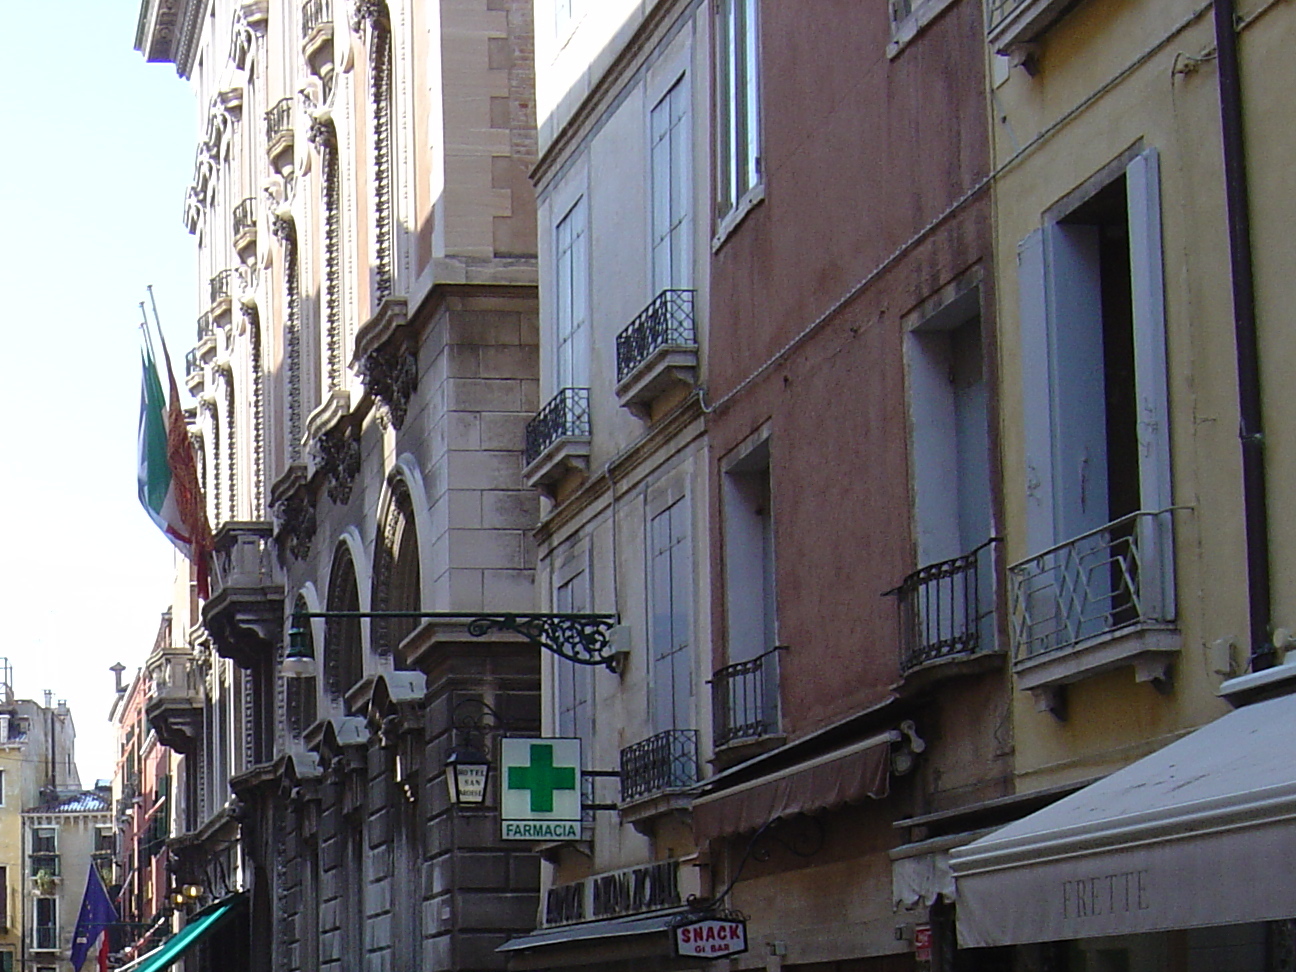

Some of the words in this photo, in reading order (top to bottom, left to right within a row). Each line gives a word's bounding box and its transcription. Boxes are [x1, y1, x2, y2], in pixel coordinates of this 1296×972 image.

[458, 768, 485, 776] HOTEL
[465, 778, 481, 787] SAN
[506, 824, 577, 837] FARMACIA
[1062, 869, 1150, 919] FRETTE
[681, 924, 741, 943] SNACK
[710, 943, 730, 953] BAR
